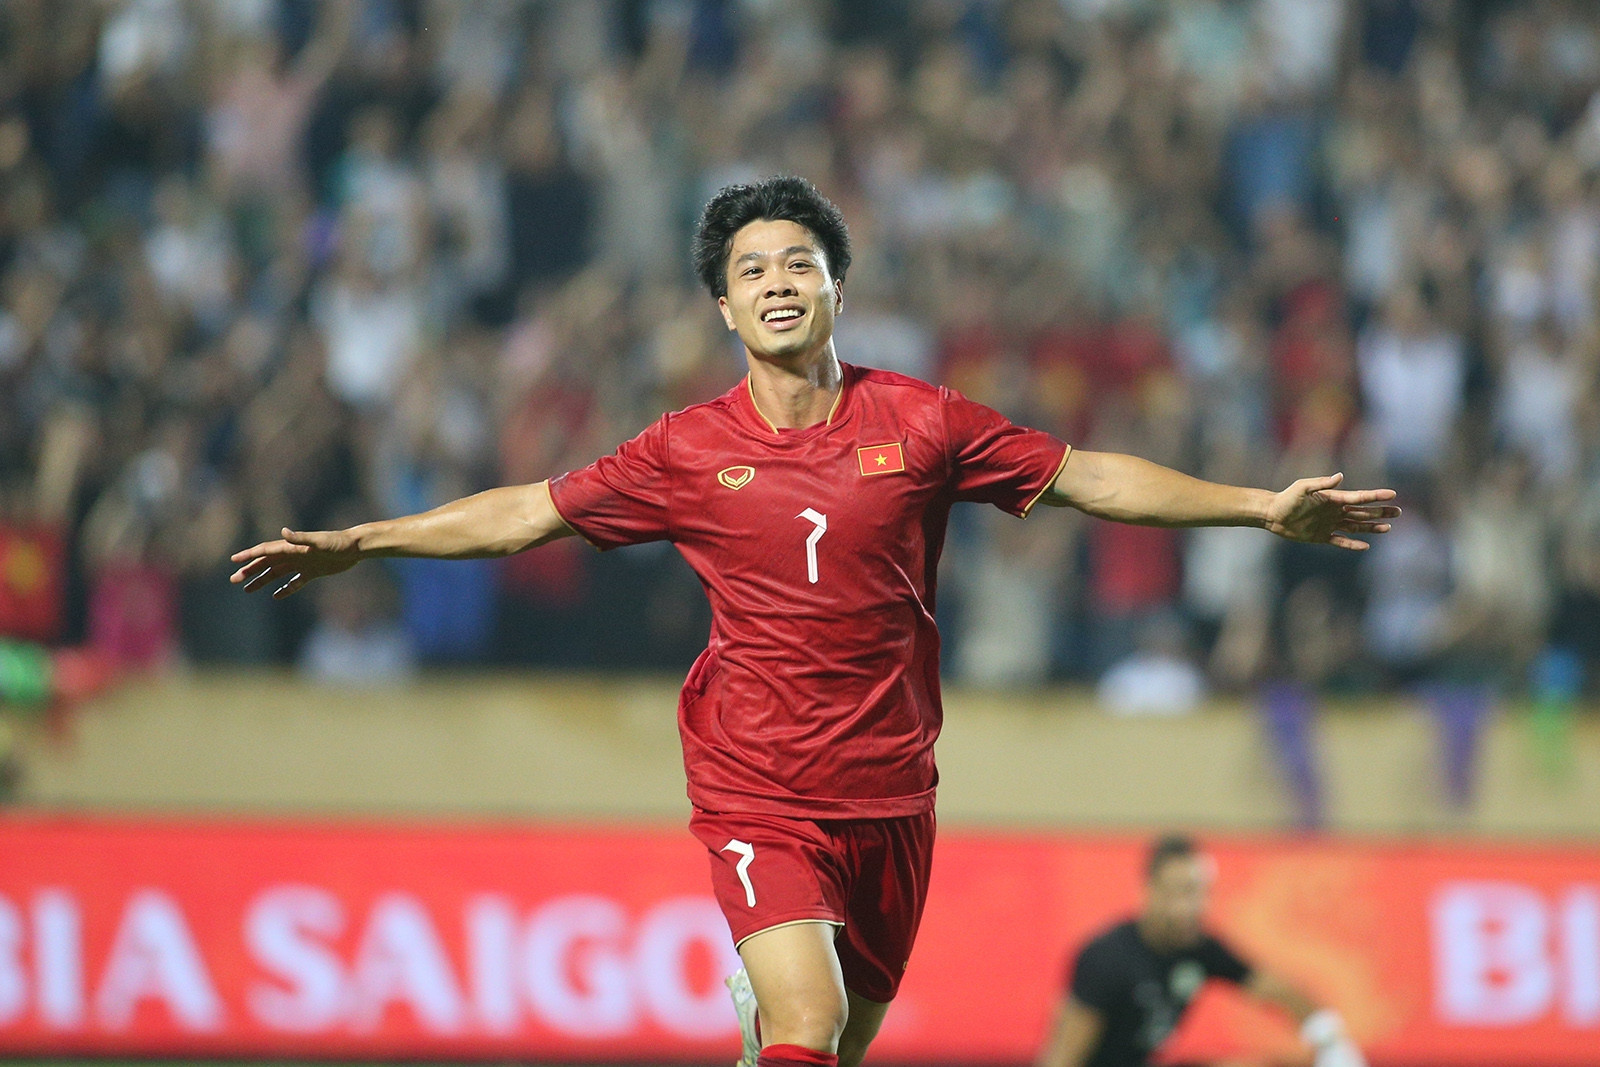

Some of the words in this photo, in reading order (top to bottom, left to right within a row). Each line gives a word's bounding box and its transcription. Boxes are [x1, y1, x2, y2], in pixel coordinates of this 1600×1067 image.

[794, 507, 827, 584] 7
[720, 838, 757, 908] 7
[0, 885, 225, 1034] IA
[243, 882, 745, 1038] SAIGO
